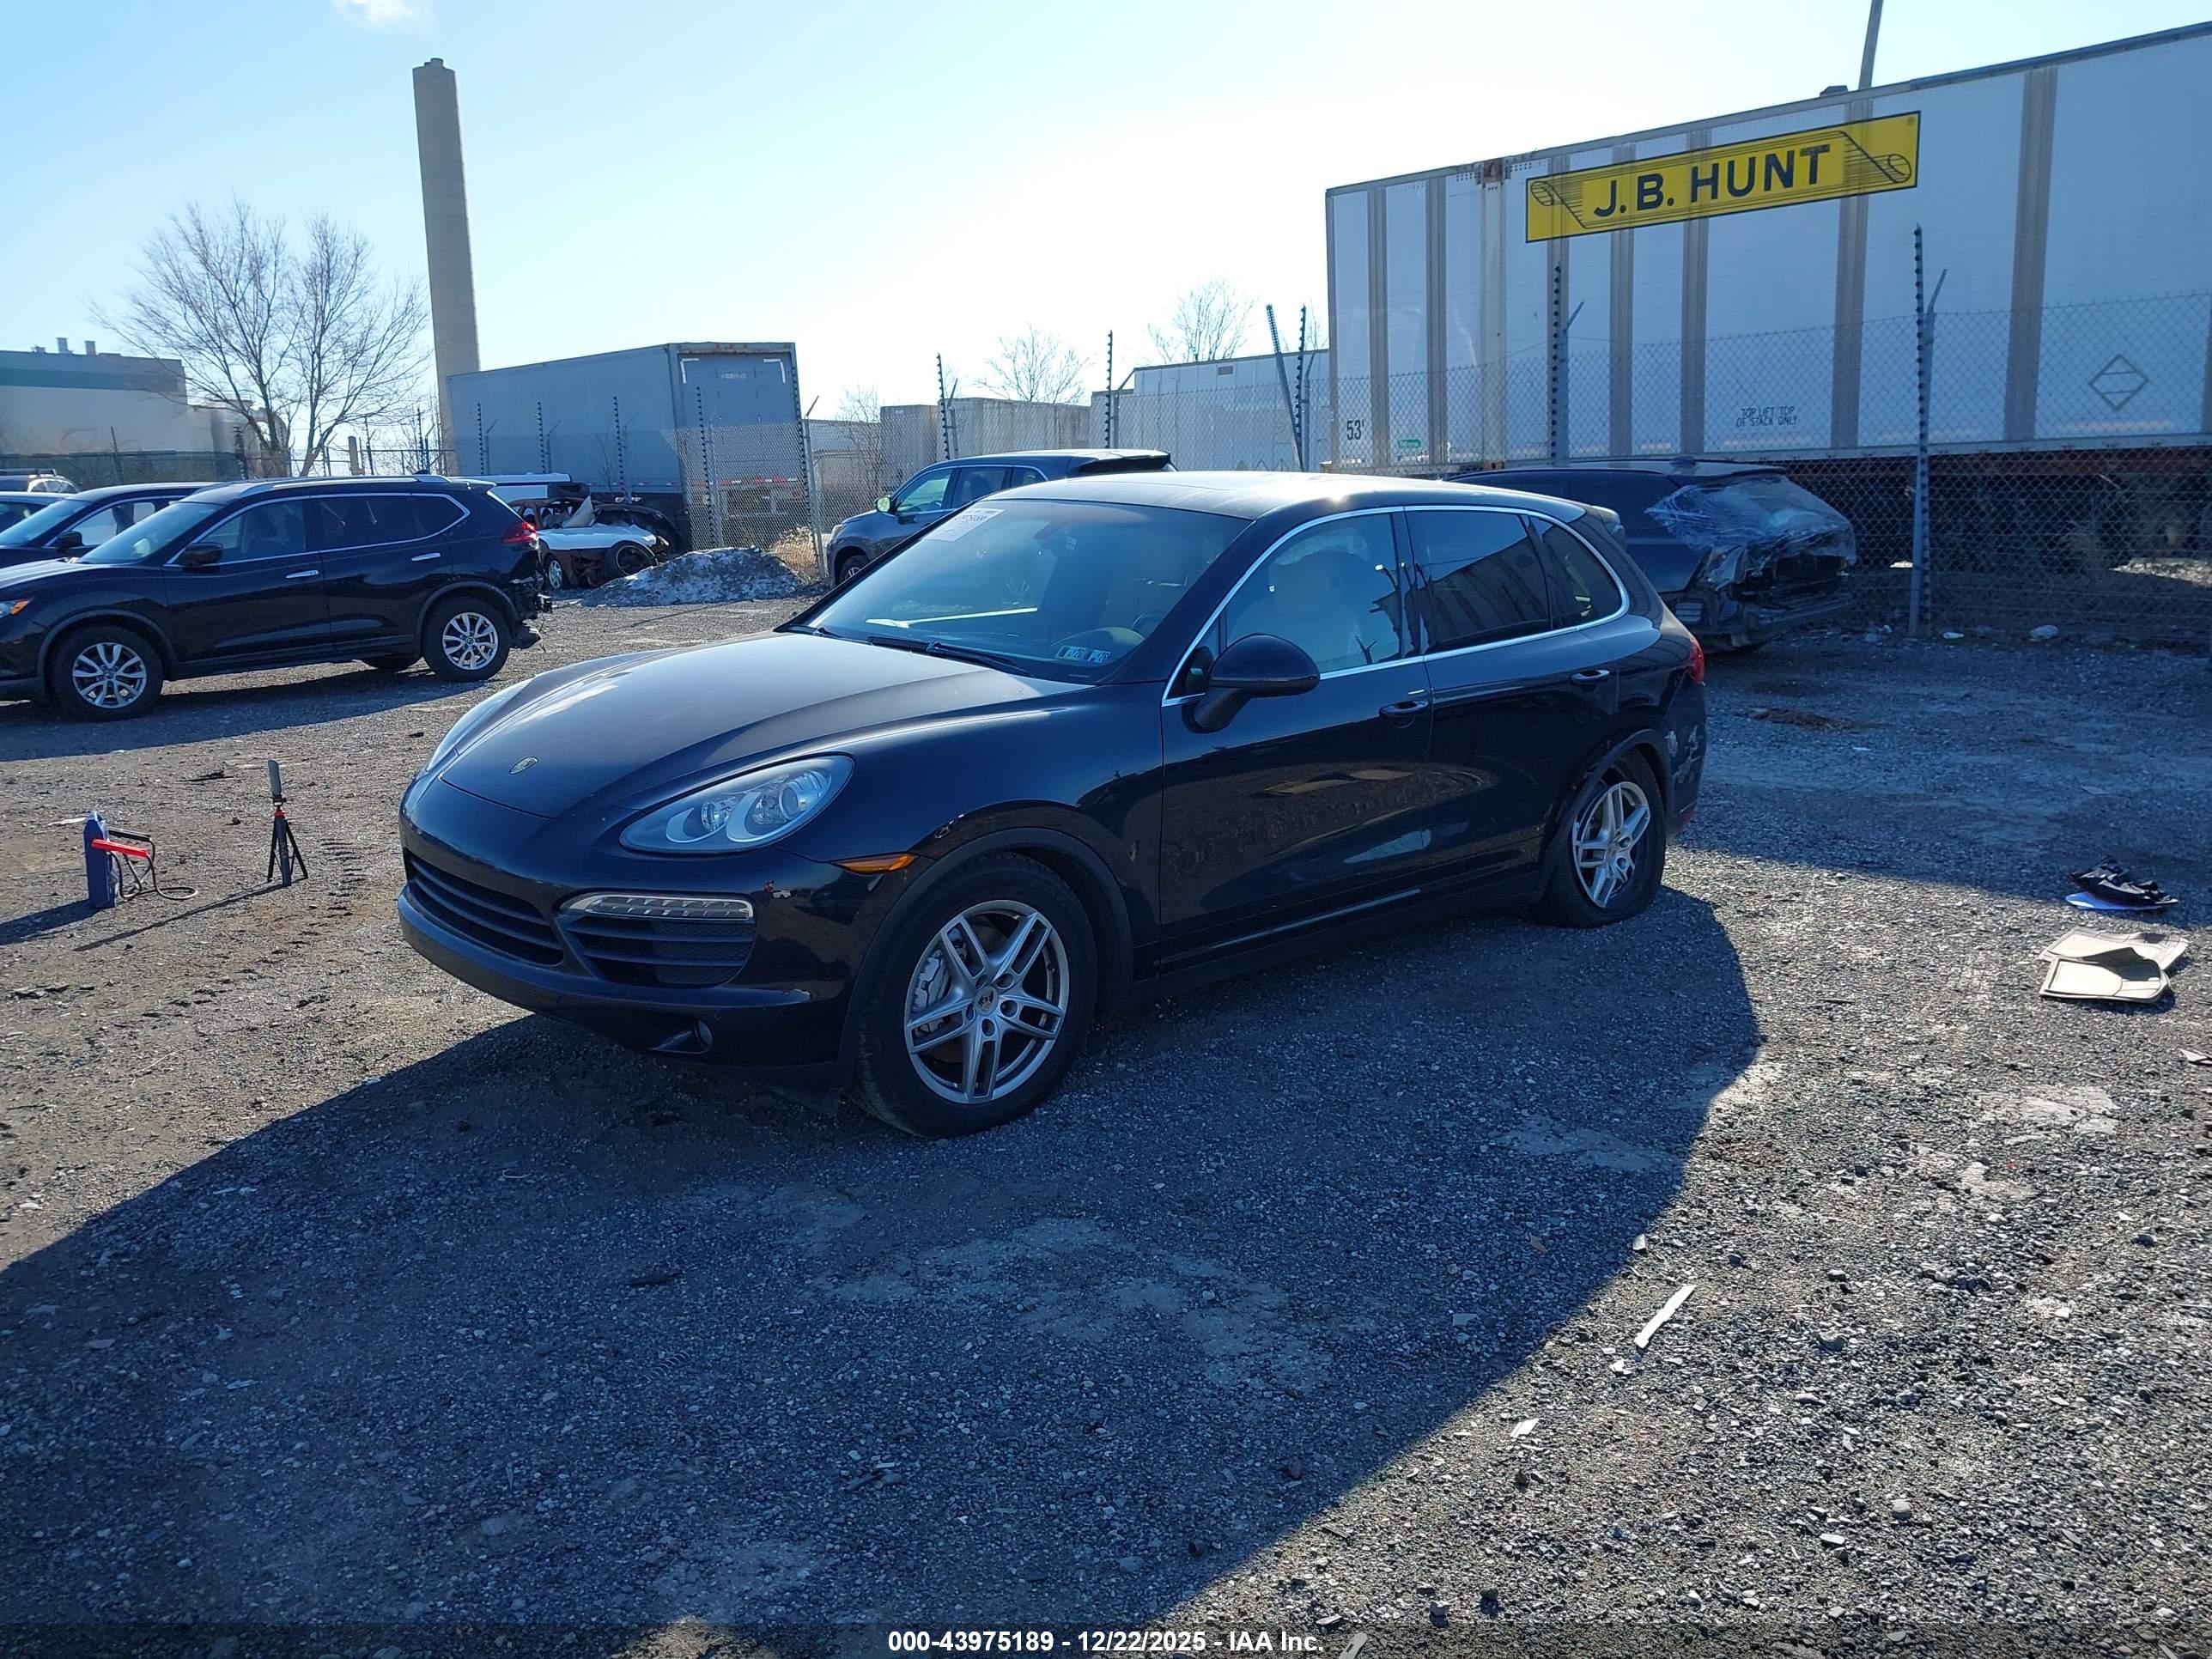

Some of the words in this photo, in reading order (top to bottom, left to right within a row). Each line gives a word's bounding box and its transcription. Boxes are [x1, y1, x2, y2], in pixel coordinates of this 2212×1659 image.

[1690, 143, 1831, 203] HUNT
[1741, 407, 1757, 418] TOP
[1759, 406, 1775, 417] LIFT
[1779, 405, 1795, 416] TOP
[1735, 417, 1747, 428] OF
[1751, 416, 1774, 427] STACK
[1778, 416, 1798, 426] ONLY
